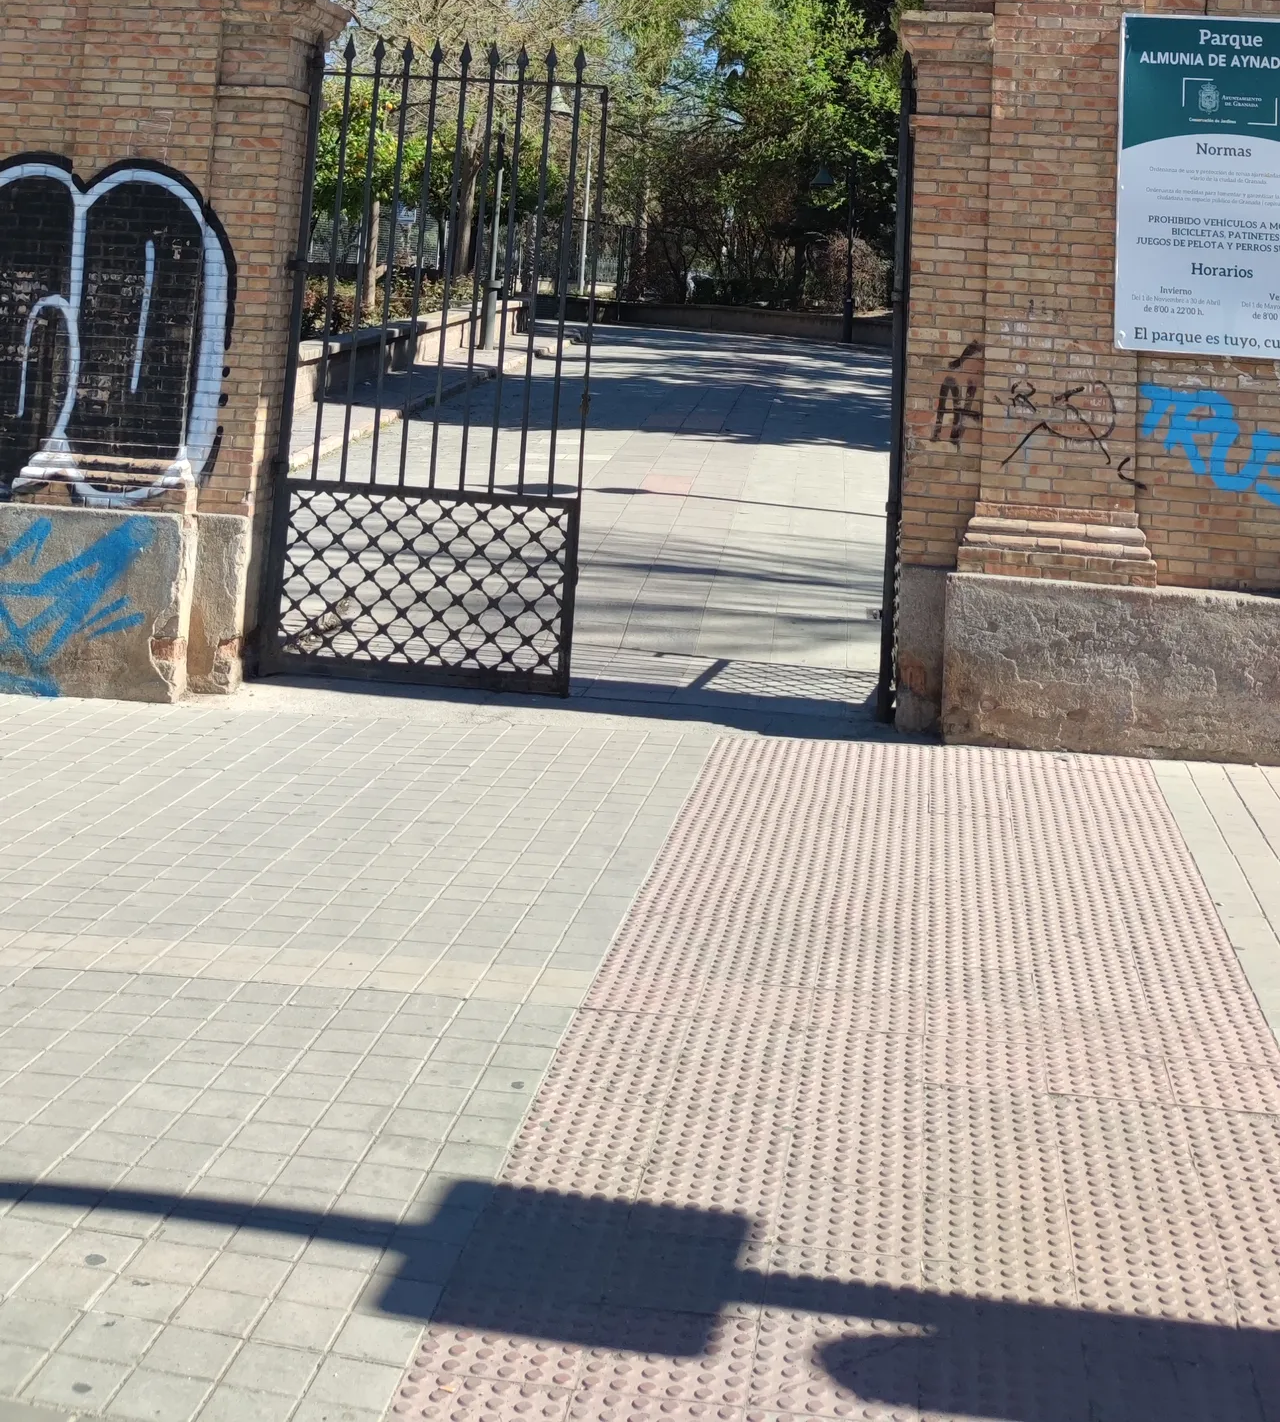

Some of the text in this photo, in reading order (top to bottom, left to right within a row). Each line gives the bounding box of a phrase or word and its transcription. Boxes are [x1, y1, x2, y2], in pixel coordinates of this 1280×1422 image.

[1199, 29, 1263, 49] Parque
[1140, 51, 1204, 66] ALMUNIA
[1208, 54, 1227, 67] DE
[1196, 142, 1252, 157] Normas
[1148, 215, 1201, 226] PROHIBIDO
[1203, 218, 1258, 229] VEHÍCULOS
[1259, 221, 1267, 230] A
[1171, 227, 1280, 242] BICICLETAS, PATINETES
[1136, 237, 1171, 246] JUEGOS
[1173, 239, 1186, 247] DE
[1187, 239, 1224, 250] PELOTA
[1227, 242, 1234, 250] Y
[1235, 243, 1272, 253] PERROS
[1191, 262, 1253, 278] Horarios
[1160, 286, 1192, 296] Invierno
[1143, 305, 1153, 313] de
[1252, 312, 1262, 320] de
[1134, 326, 1147, 340] El
[1151, 330, 1202, 345] parque
[1205, 334, 1220, 345] es
[1224, 334, 1260, 349] tuyo,
